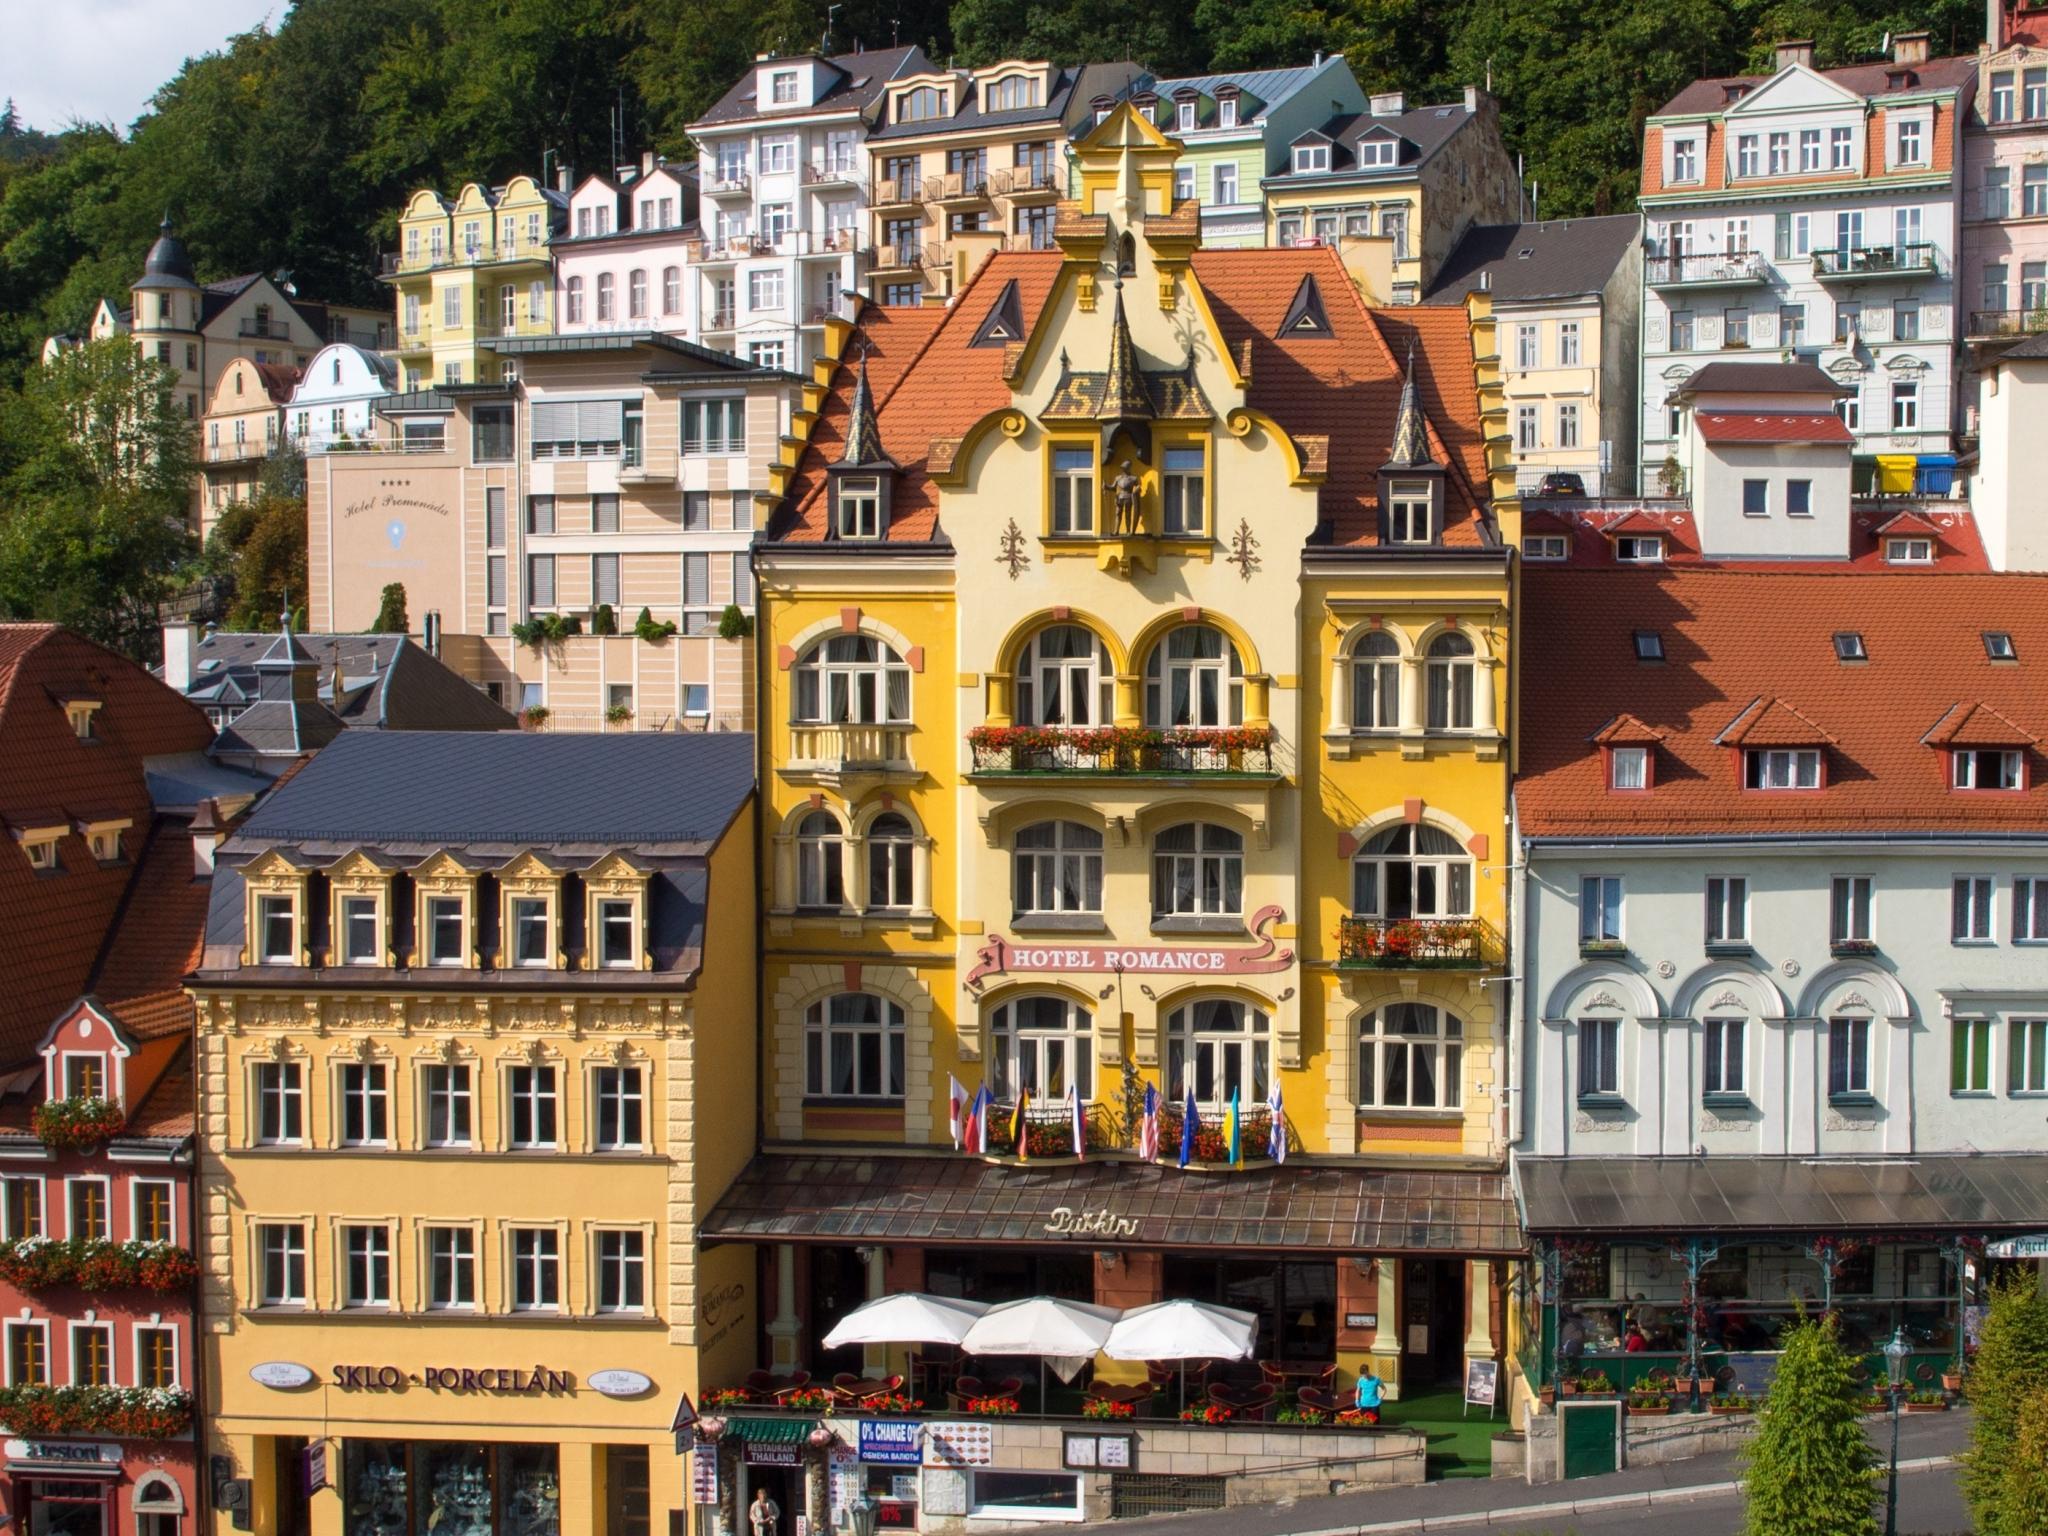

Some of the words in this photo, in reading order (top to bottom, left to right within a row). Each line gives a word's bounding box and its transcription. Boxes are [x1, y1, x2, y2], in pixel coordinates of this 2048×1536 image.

[344, 497, 377, 518] Hotel
[1013, 949, 1096, 968] HOTEL
[1104, 951, 1225, 969] ROMANCE
[332, 1365, 400, 1387] SKLO
[861, 1422, 874, 1441] 0%
[875, 1423, 907, 1442] CHANGE
[751, 1452, 796, 1463] THAILAND
